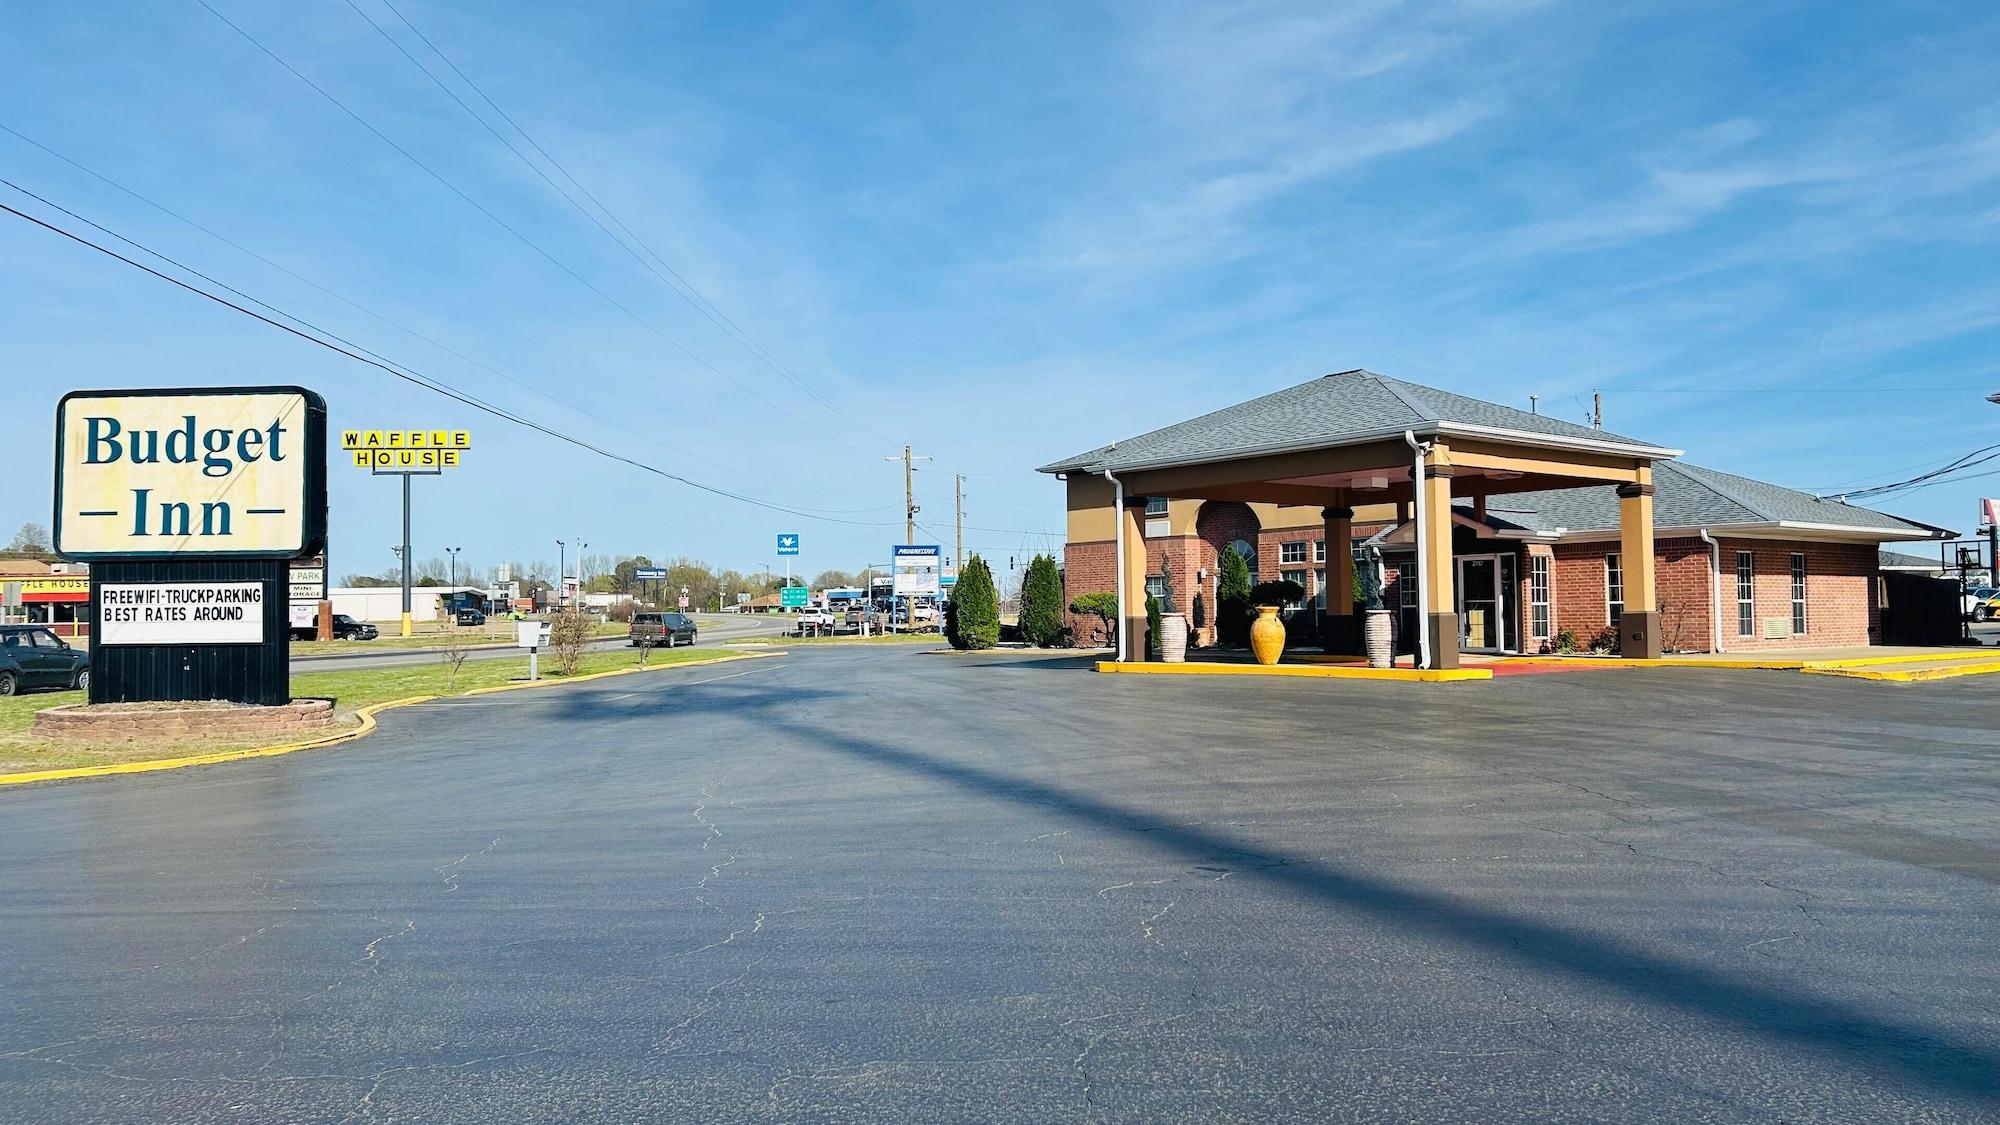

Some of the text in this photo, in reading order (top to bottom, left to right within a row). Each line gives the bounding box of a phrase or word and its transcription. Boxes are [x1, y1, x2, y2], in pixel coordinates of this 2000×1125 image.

[81, 415, 287, 477] Budget
[345, 433, 465, 445] WAFFLE
[357, 453, 455, 464] HOUSE
[128, 489, 233, 536] Inn
[297, 572, 320, 580] PARK
[52, 579, 89, 588] HOUSE
[103, 588, 261, 604] FREEWIFI-TRUCKPARKING
[104, 606, 243, 622] BEST RATES AROUND
